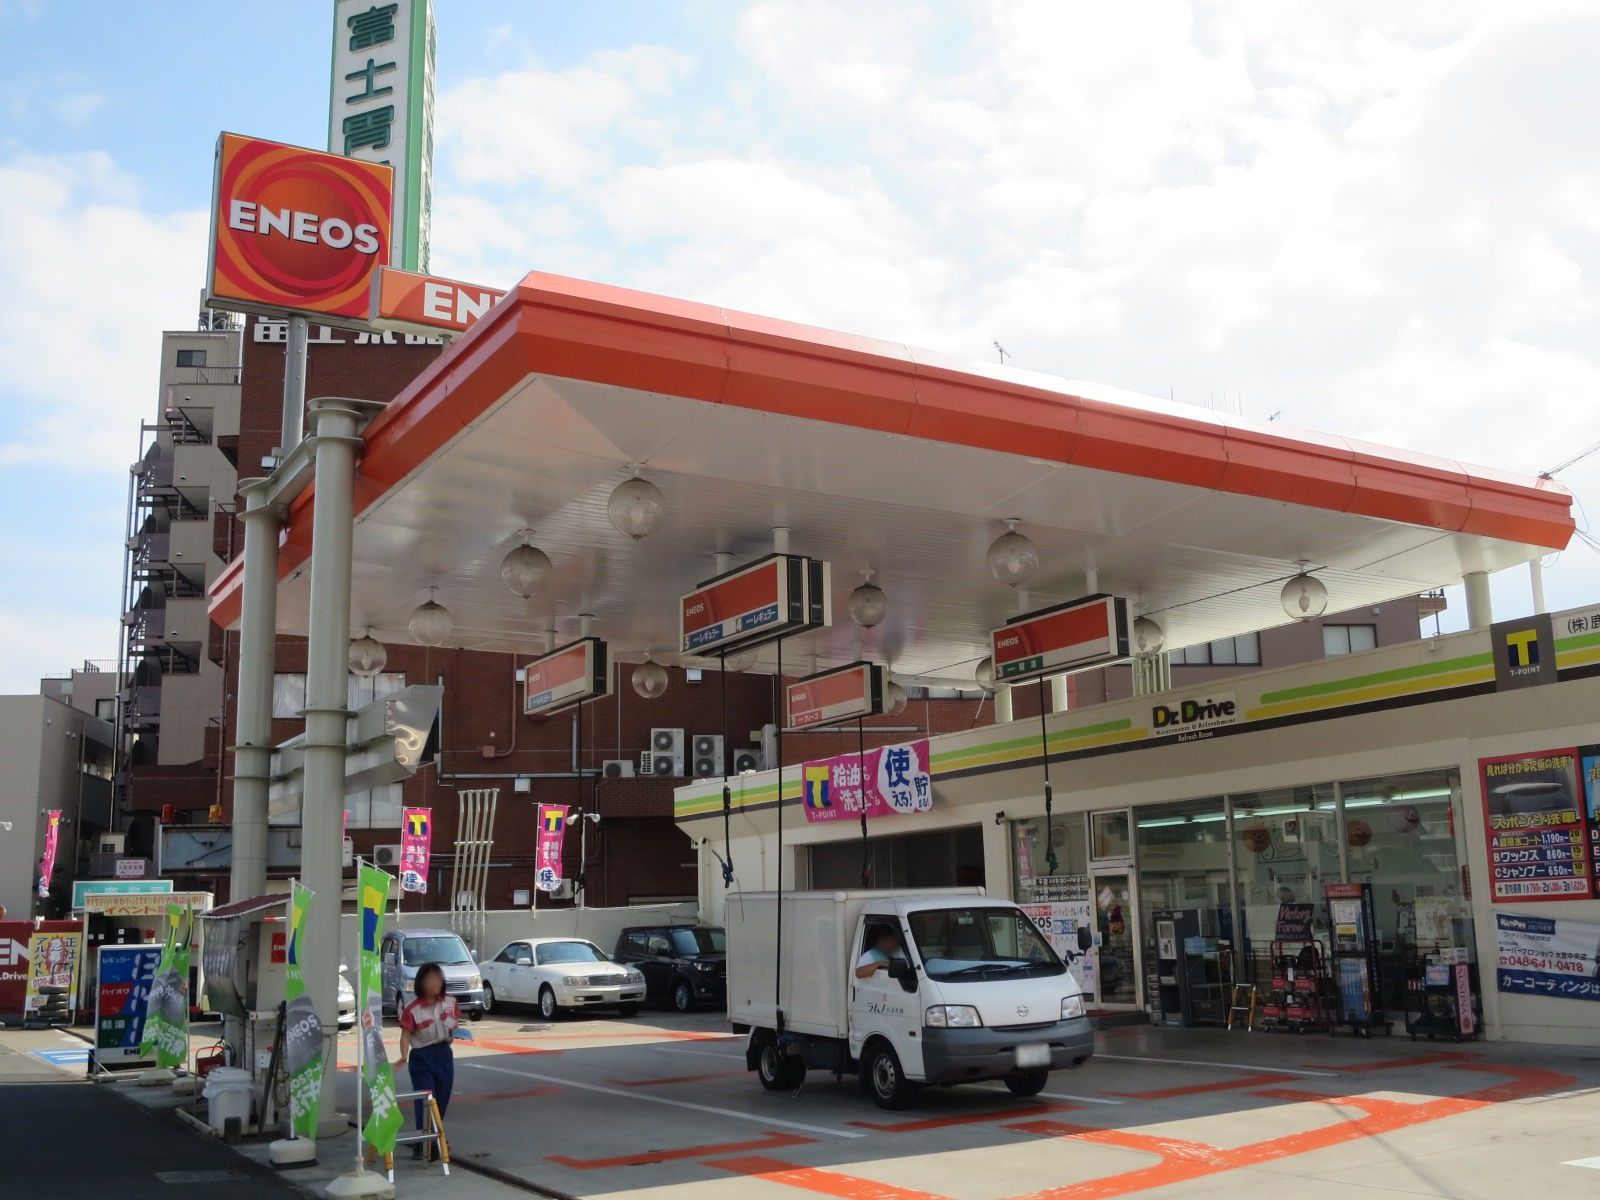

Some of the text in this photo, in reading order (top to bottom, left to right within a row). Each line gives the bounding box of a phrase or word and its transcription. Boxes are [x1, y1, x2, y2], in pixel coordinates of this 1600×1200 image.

[341, 3, 398, 164] 富士胃
[229, 198, 380, 255] ENEOS
[423, 281, 506, 324] EN
[686, 603, 704, 617] ENEOS
[753, 609, 776, 624] レギュラー
[684, 629, 720, 650] 5 レギュラー
[997, 636, 1019, 649] ENEOS
[997, 665, 1003, 678] 3
[1510, 665, 1541, 677] T-POINT
[1181, 699, 1235, 723] Drive
[1155, 725, 1190, 736] Maintenance
[1198, 718, 1236, 729] Refreshment
[1178, 731, 1214, 742] Refresh Room
[1486, 755, 1572, 777] 見れば分かる究極の洗車!
[811, 808, 837, 819] T-POINT
[1493, 811, 1577, 830] スポンジ洗車
[1492, 837, 1499, 847] A
[1592, 830, 1598, 840] D
[1493, 853, 1500, 862] B
[1500, 849, 1540, 863] ワックス
[1495, 868, 1501, 878] C
[1502, 865, 1545, 878] シャンプー
[104, 905, 165, 914] イベント
[1508, 956, 1584, 973] 048-641-0478
[1457, 968, 1467, 1015] SUSTINA
[1502, 974, 1600, 995] カーコーティングは
[101, 988, 130, 996] ハイオク
